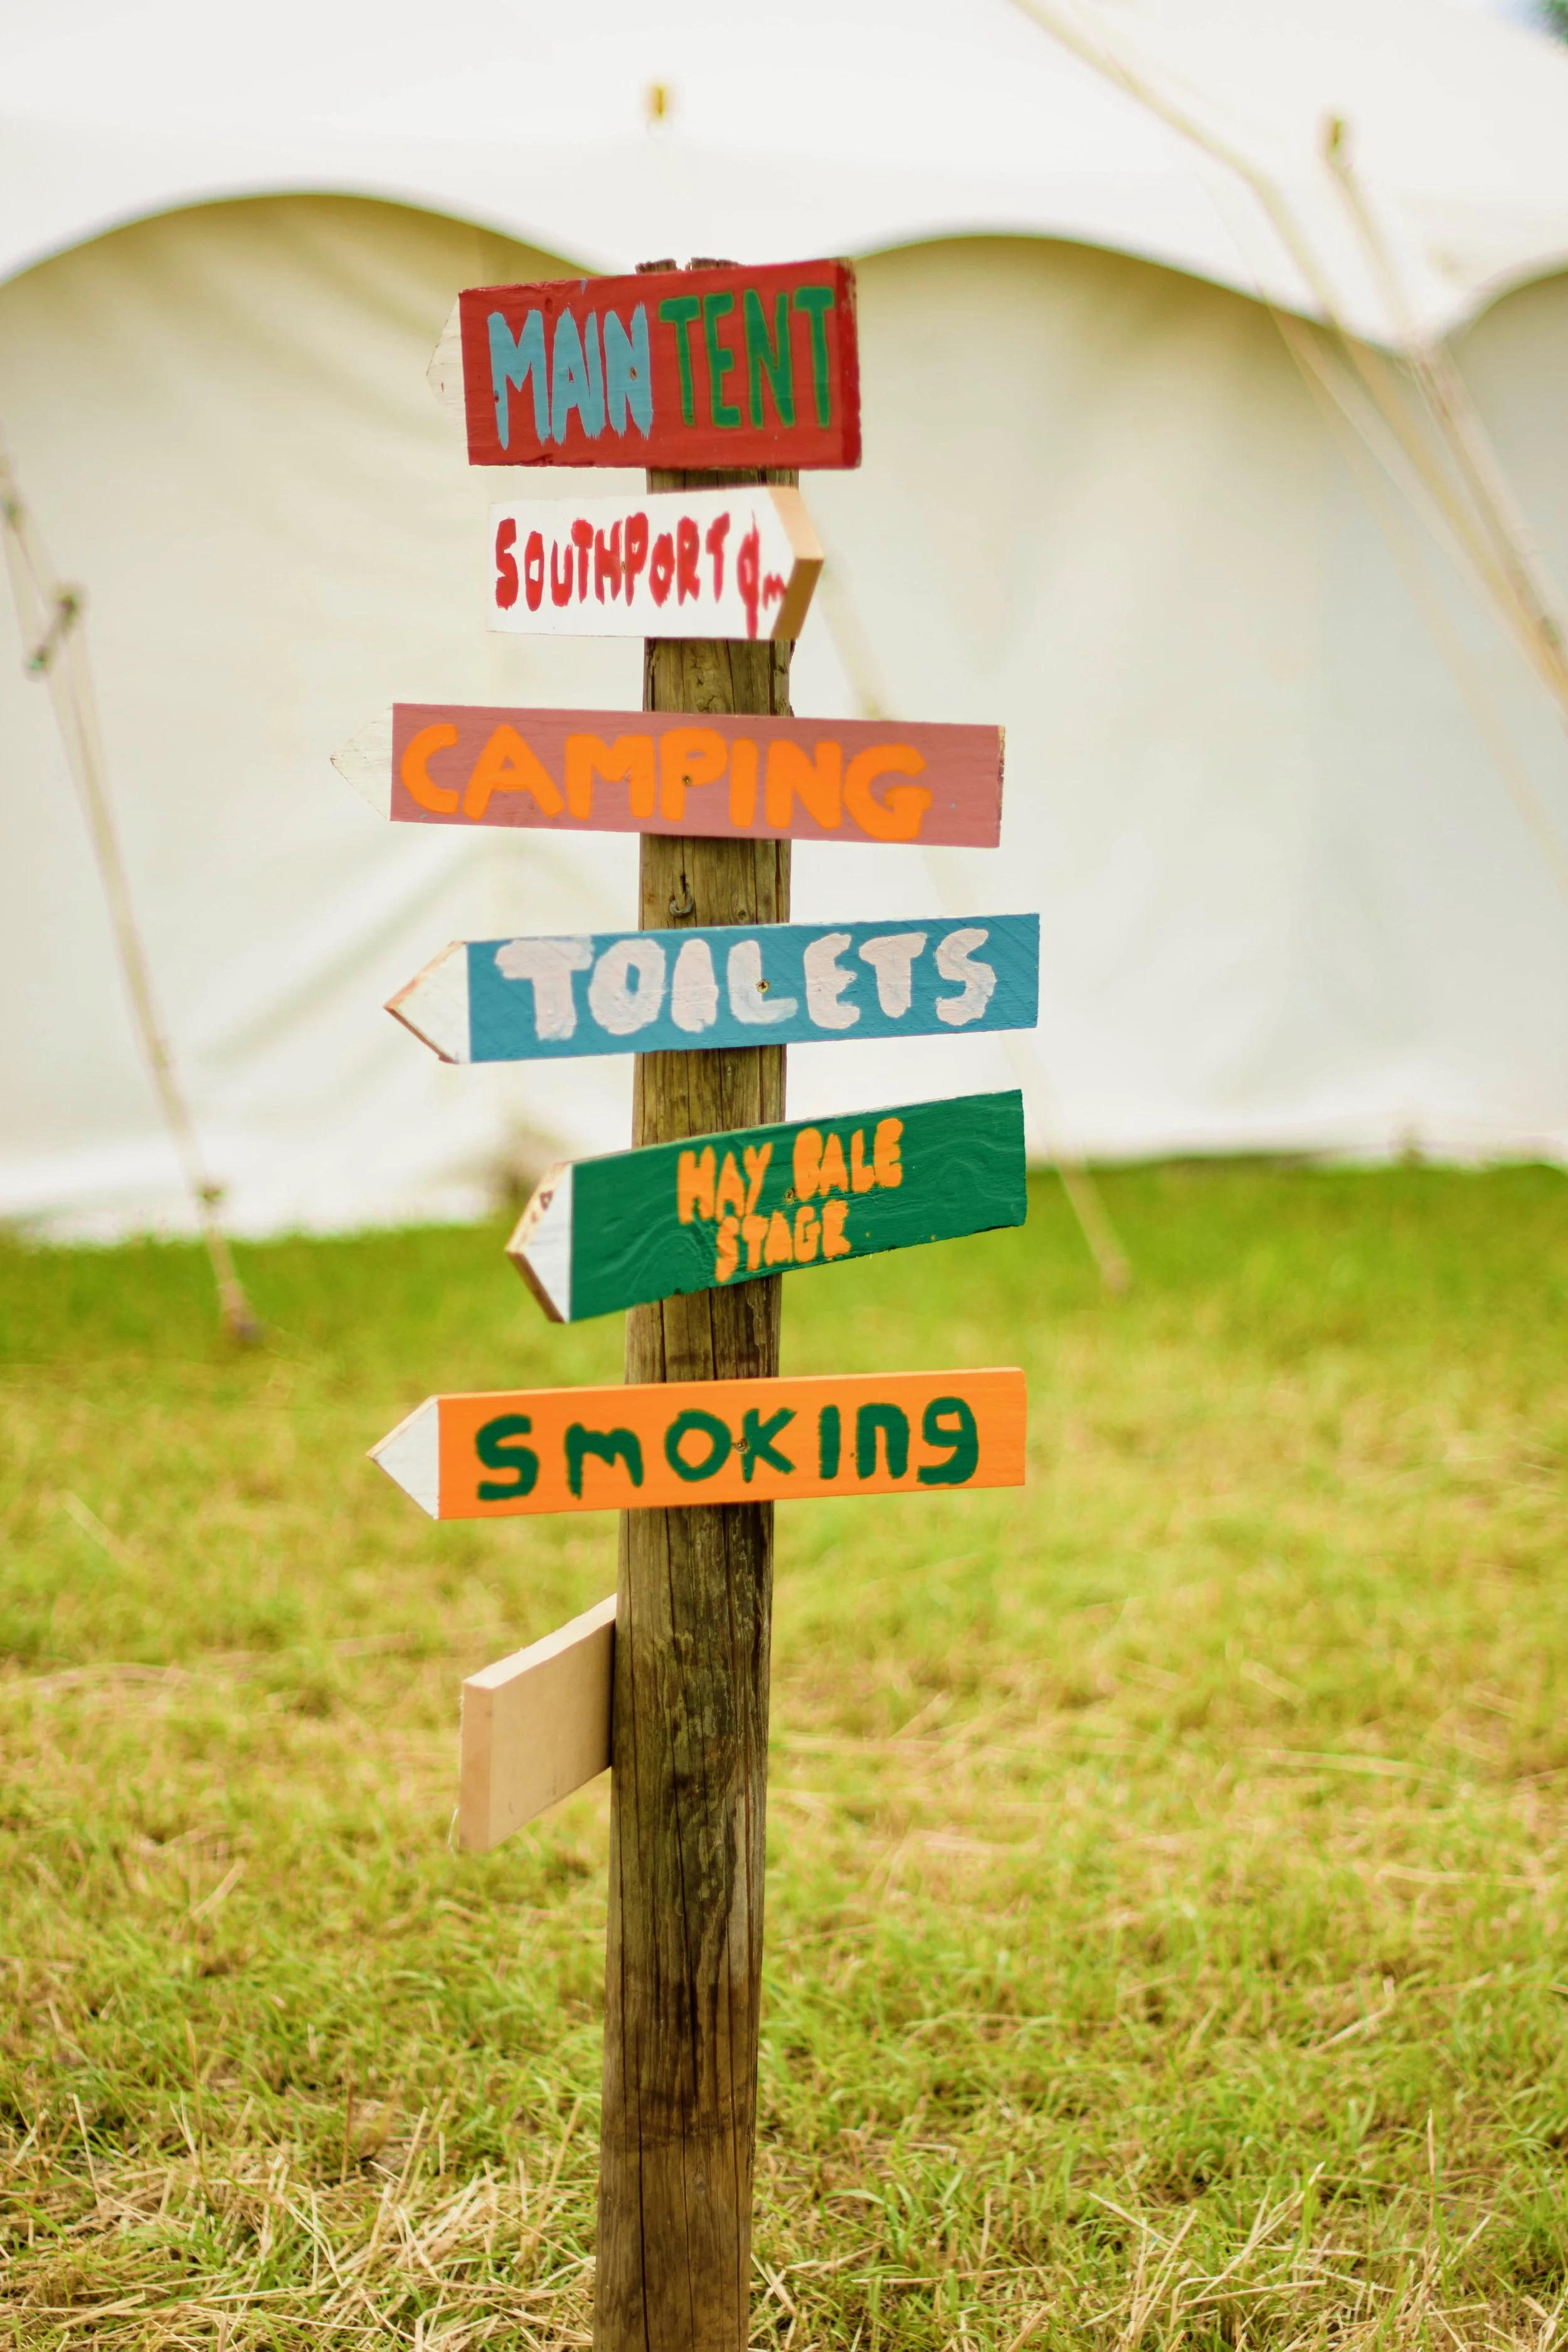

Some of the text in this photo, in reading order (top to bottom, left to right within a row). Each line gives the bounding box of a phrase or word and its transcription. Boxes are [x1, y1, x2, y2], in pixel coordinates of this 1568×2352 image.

[487, 286, 835, 450] MAIN TENT
[494, 512, 729, 612] SOUTHPORT
[400, 724, 932, 841] CAMPING
[495, 928, 996, 1040] TOILETS
[677, 1117, 904, 1225] HAY BALE
[714, 1199, 850, 1283] STAGE
